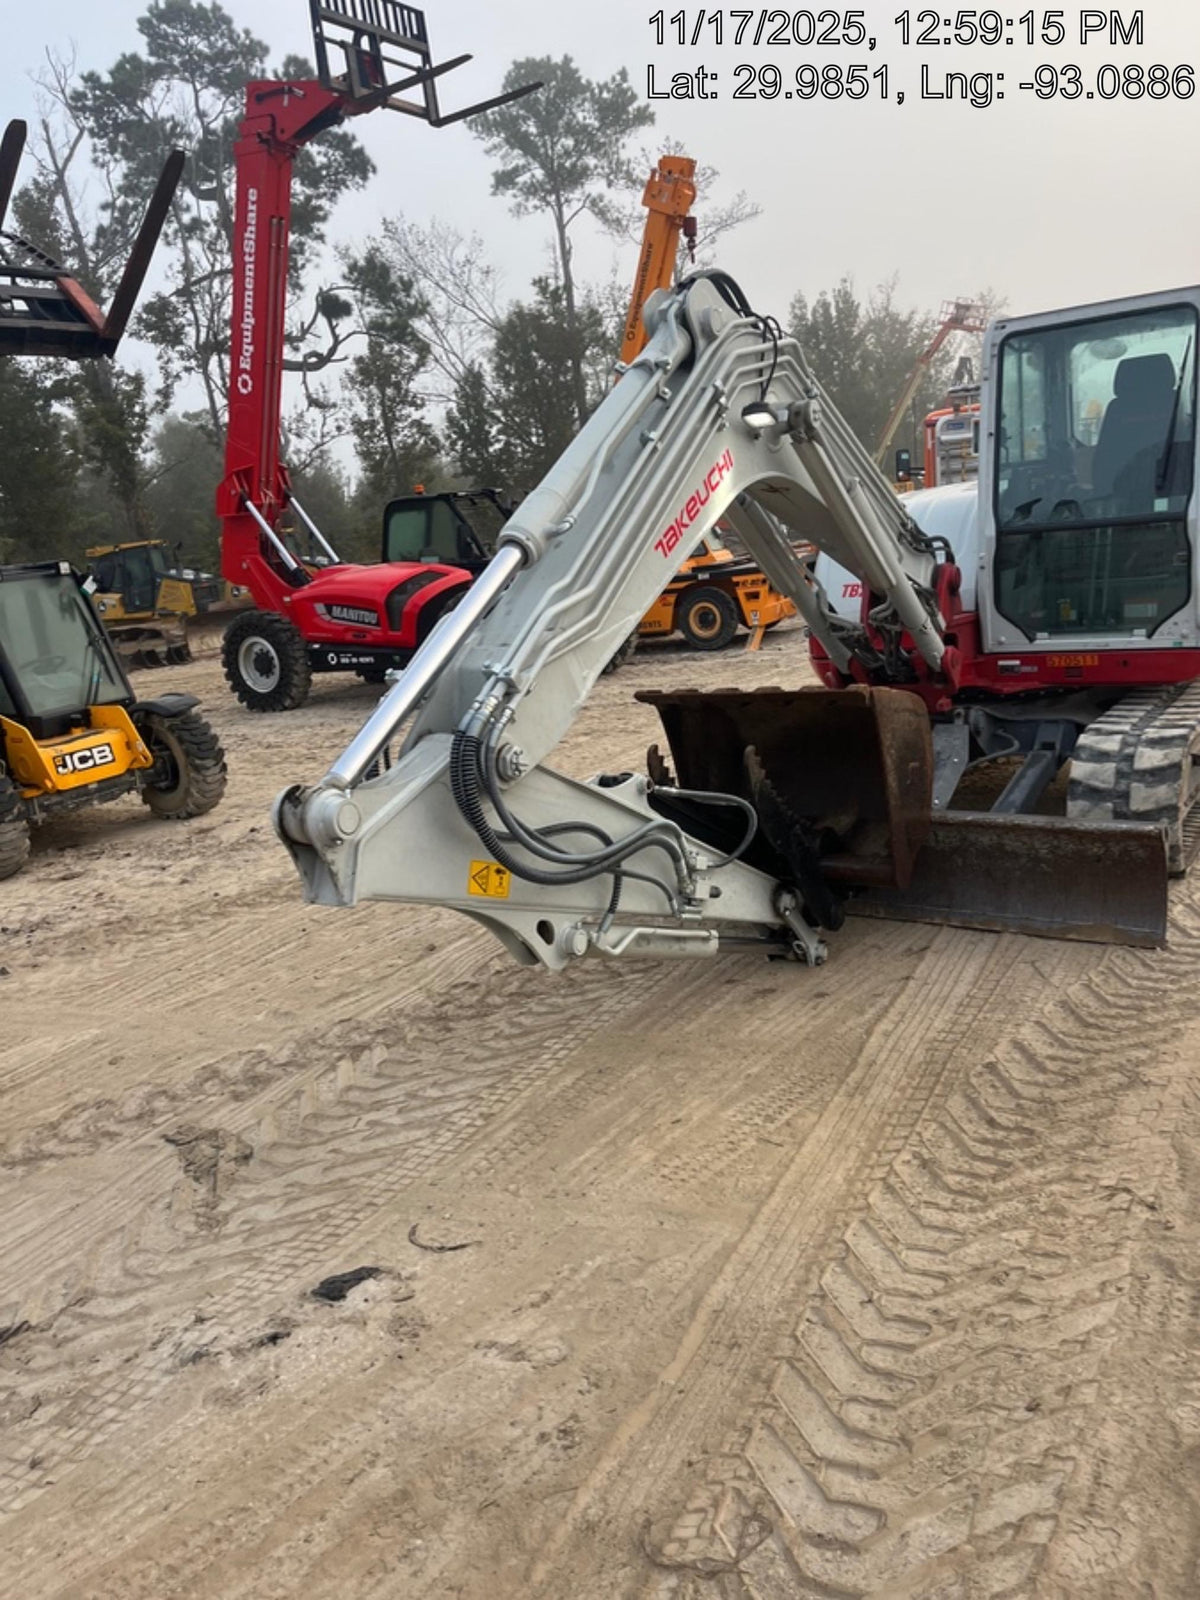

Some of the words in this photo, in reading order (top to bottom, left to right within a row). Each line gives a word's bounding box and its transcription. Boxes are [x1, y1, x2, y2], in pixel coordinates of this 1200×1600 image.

[239, 187, 258, 370] EquipmentShare
[331, 605, 379, 625] MANITOU
[57, 744, 114, 775] JCB
